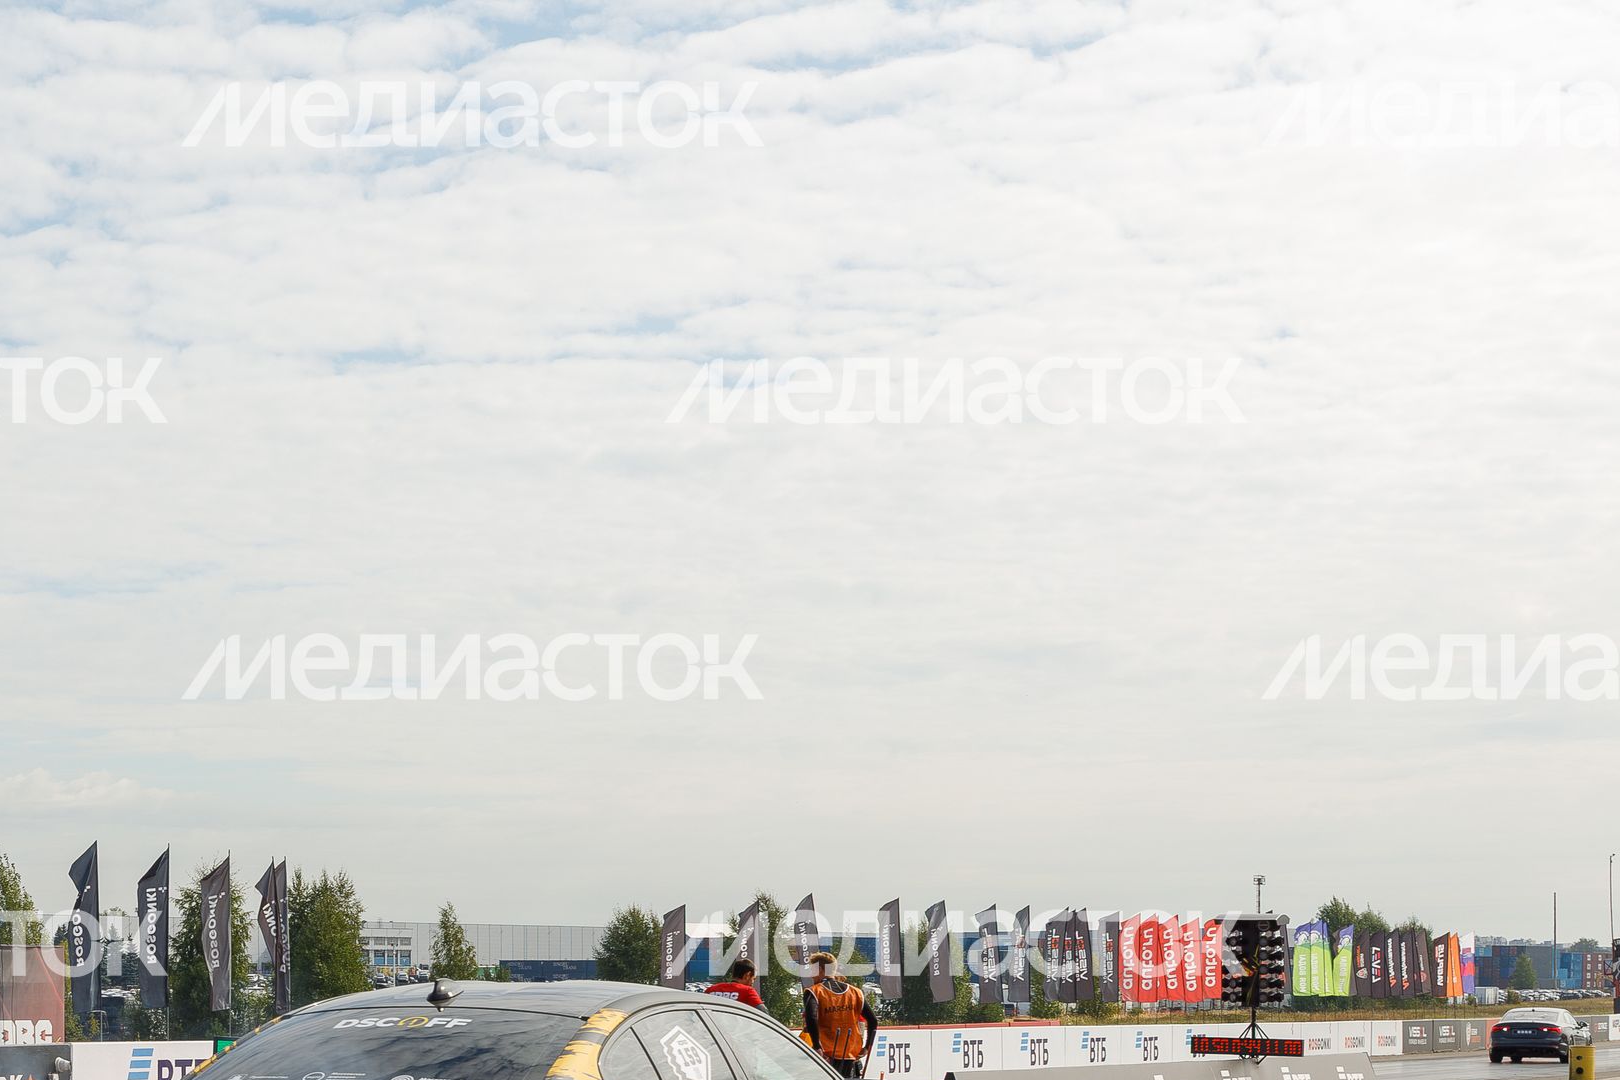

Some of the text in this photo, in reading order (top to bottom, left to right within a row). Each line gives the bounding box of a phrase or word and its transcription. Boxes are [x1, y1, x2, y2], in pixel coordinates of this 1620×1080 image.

[888, 1043, 912, 1074] ВТБ
[963, 1040, 984, 1068] ВТБ
[1030, 1038, 1049, 1066] ВТБ
[1090, 1038, 1107, 1062] ВТБ
[1143, 1037, 1158, 1062] ВТБ
